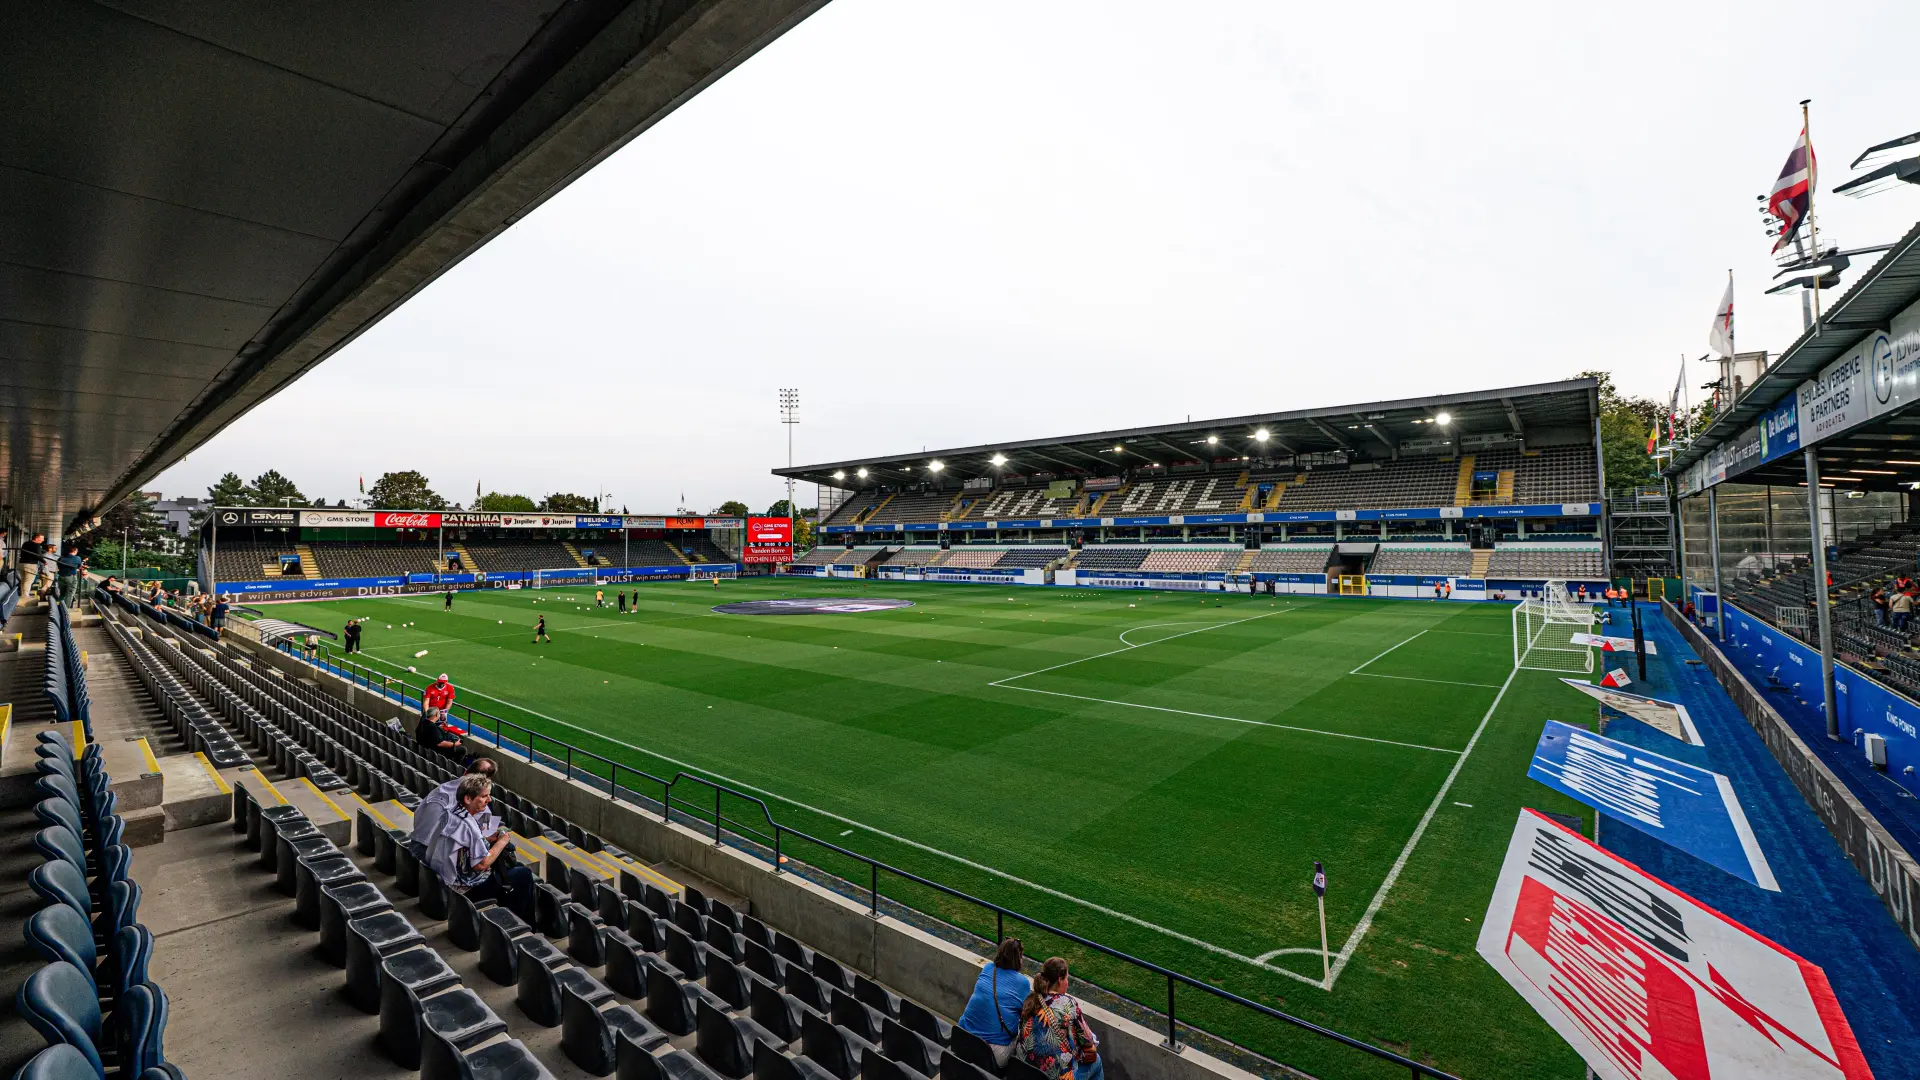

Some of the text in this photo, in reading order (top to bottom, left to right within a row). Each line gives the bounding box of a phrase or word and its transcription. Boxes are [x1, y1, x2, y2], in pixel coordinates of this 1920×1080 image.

[1826, 355, 1861, 390] VERBEKE
[1811, 388, 1850, 422] & PARTNERS
[1816, 412, 1846, 432] ADVOCATEN
[441, 513, 500, 522] PATRIMA
[603, 574, 634, 583] DULST
[248, 593, 271, 602] wijn
[274, 591, 296, 600] met
[299, 589, 333, 598] advies
[357, 584, 404, 596] DULST
[448, 581, 475, 590] advies
[1835, 680, 1848, 695] POWER
[1886, 710, 1917, 739] KING POWER
[1866, 827, 1920, 952] DUL
